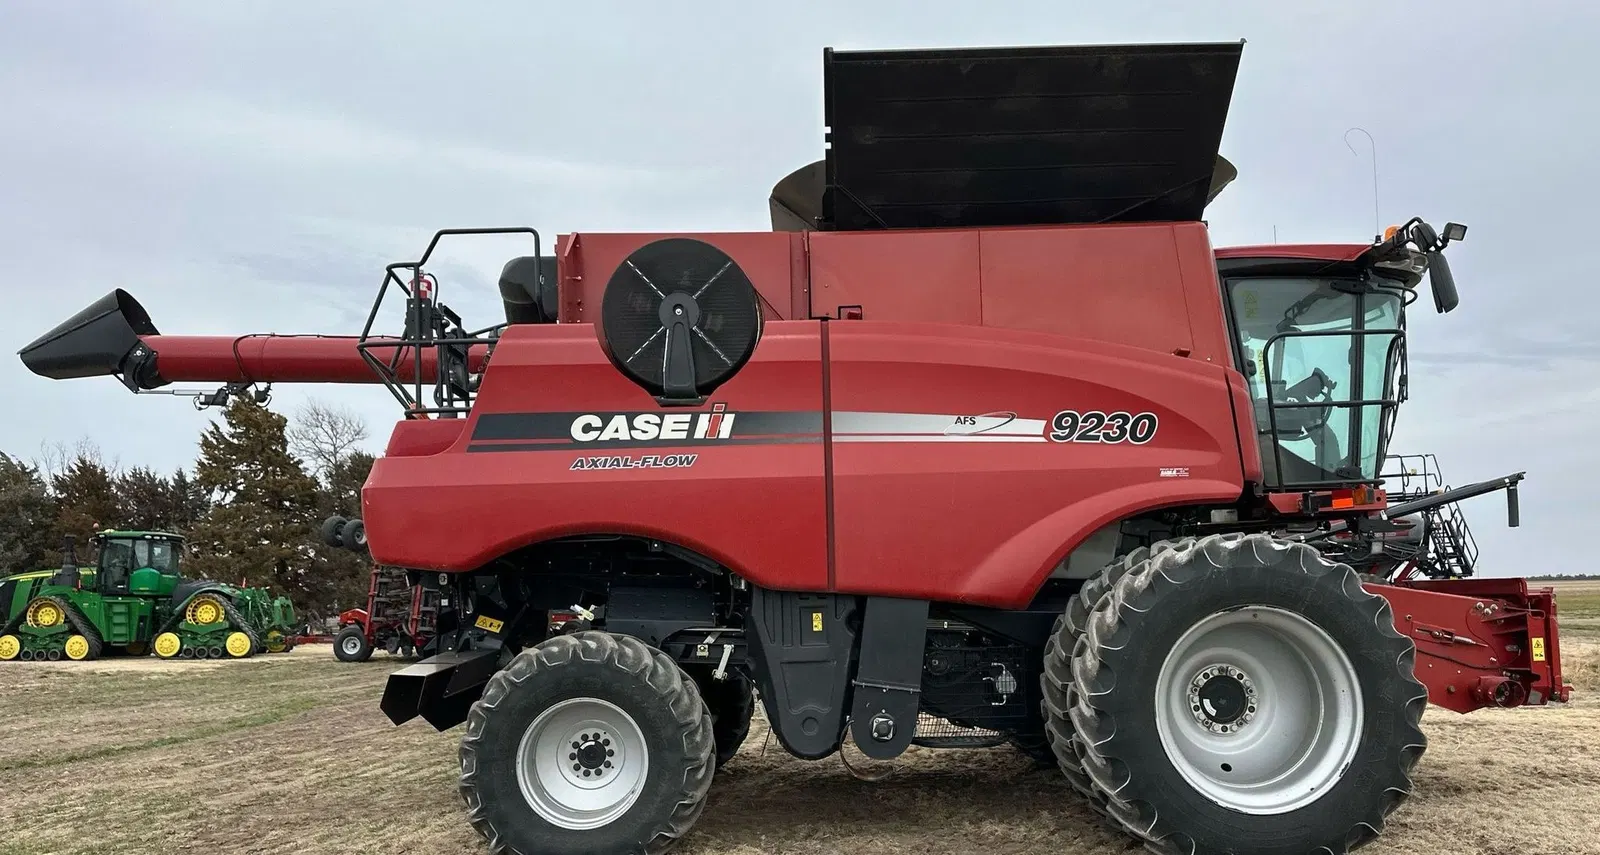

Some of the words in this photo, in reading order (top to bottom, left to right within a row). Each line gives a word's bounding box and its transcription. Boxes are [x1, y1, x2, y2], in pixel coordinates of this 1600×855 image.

[570, 414, 691, 441] CASE
[954, 416, 976, 425] AFS
[1050, 410, 1158, 444] 9230
[570, 454, 698, 470] AXIAL-FLOW
